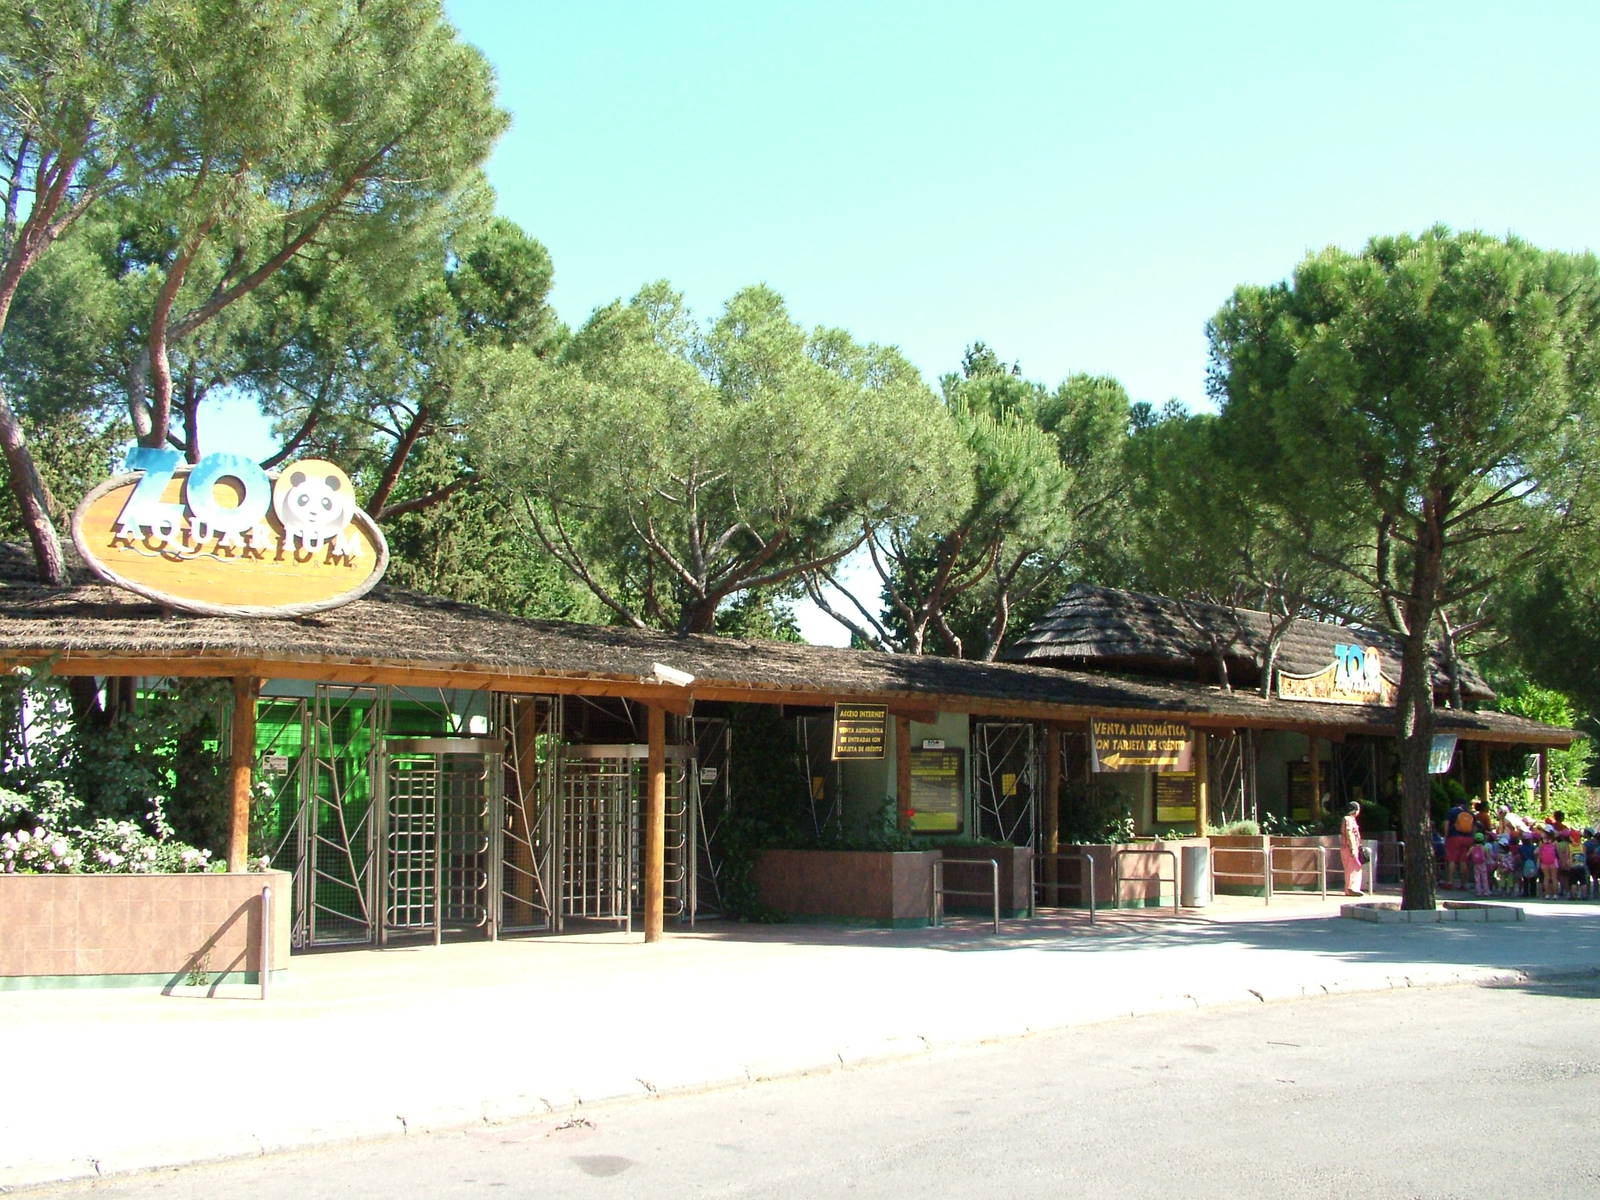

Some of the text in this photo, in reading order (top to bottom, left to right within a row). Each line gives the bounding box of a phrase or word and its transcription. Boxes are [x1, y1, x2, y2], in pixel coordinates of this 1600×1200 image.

[114, 516, 362, 559] AQUARIUM
[859, 710, 885, 718] INTERNET
[1094, 721, 1186, 736] VENTA AUTOMÁTICA
[837, 745, 857, 753] TARJETA
[1095, 737, 1185, 751] ON TARJETA DE CRÉDITO
